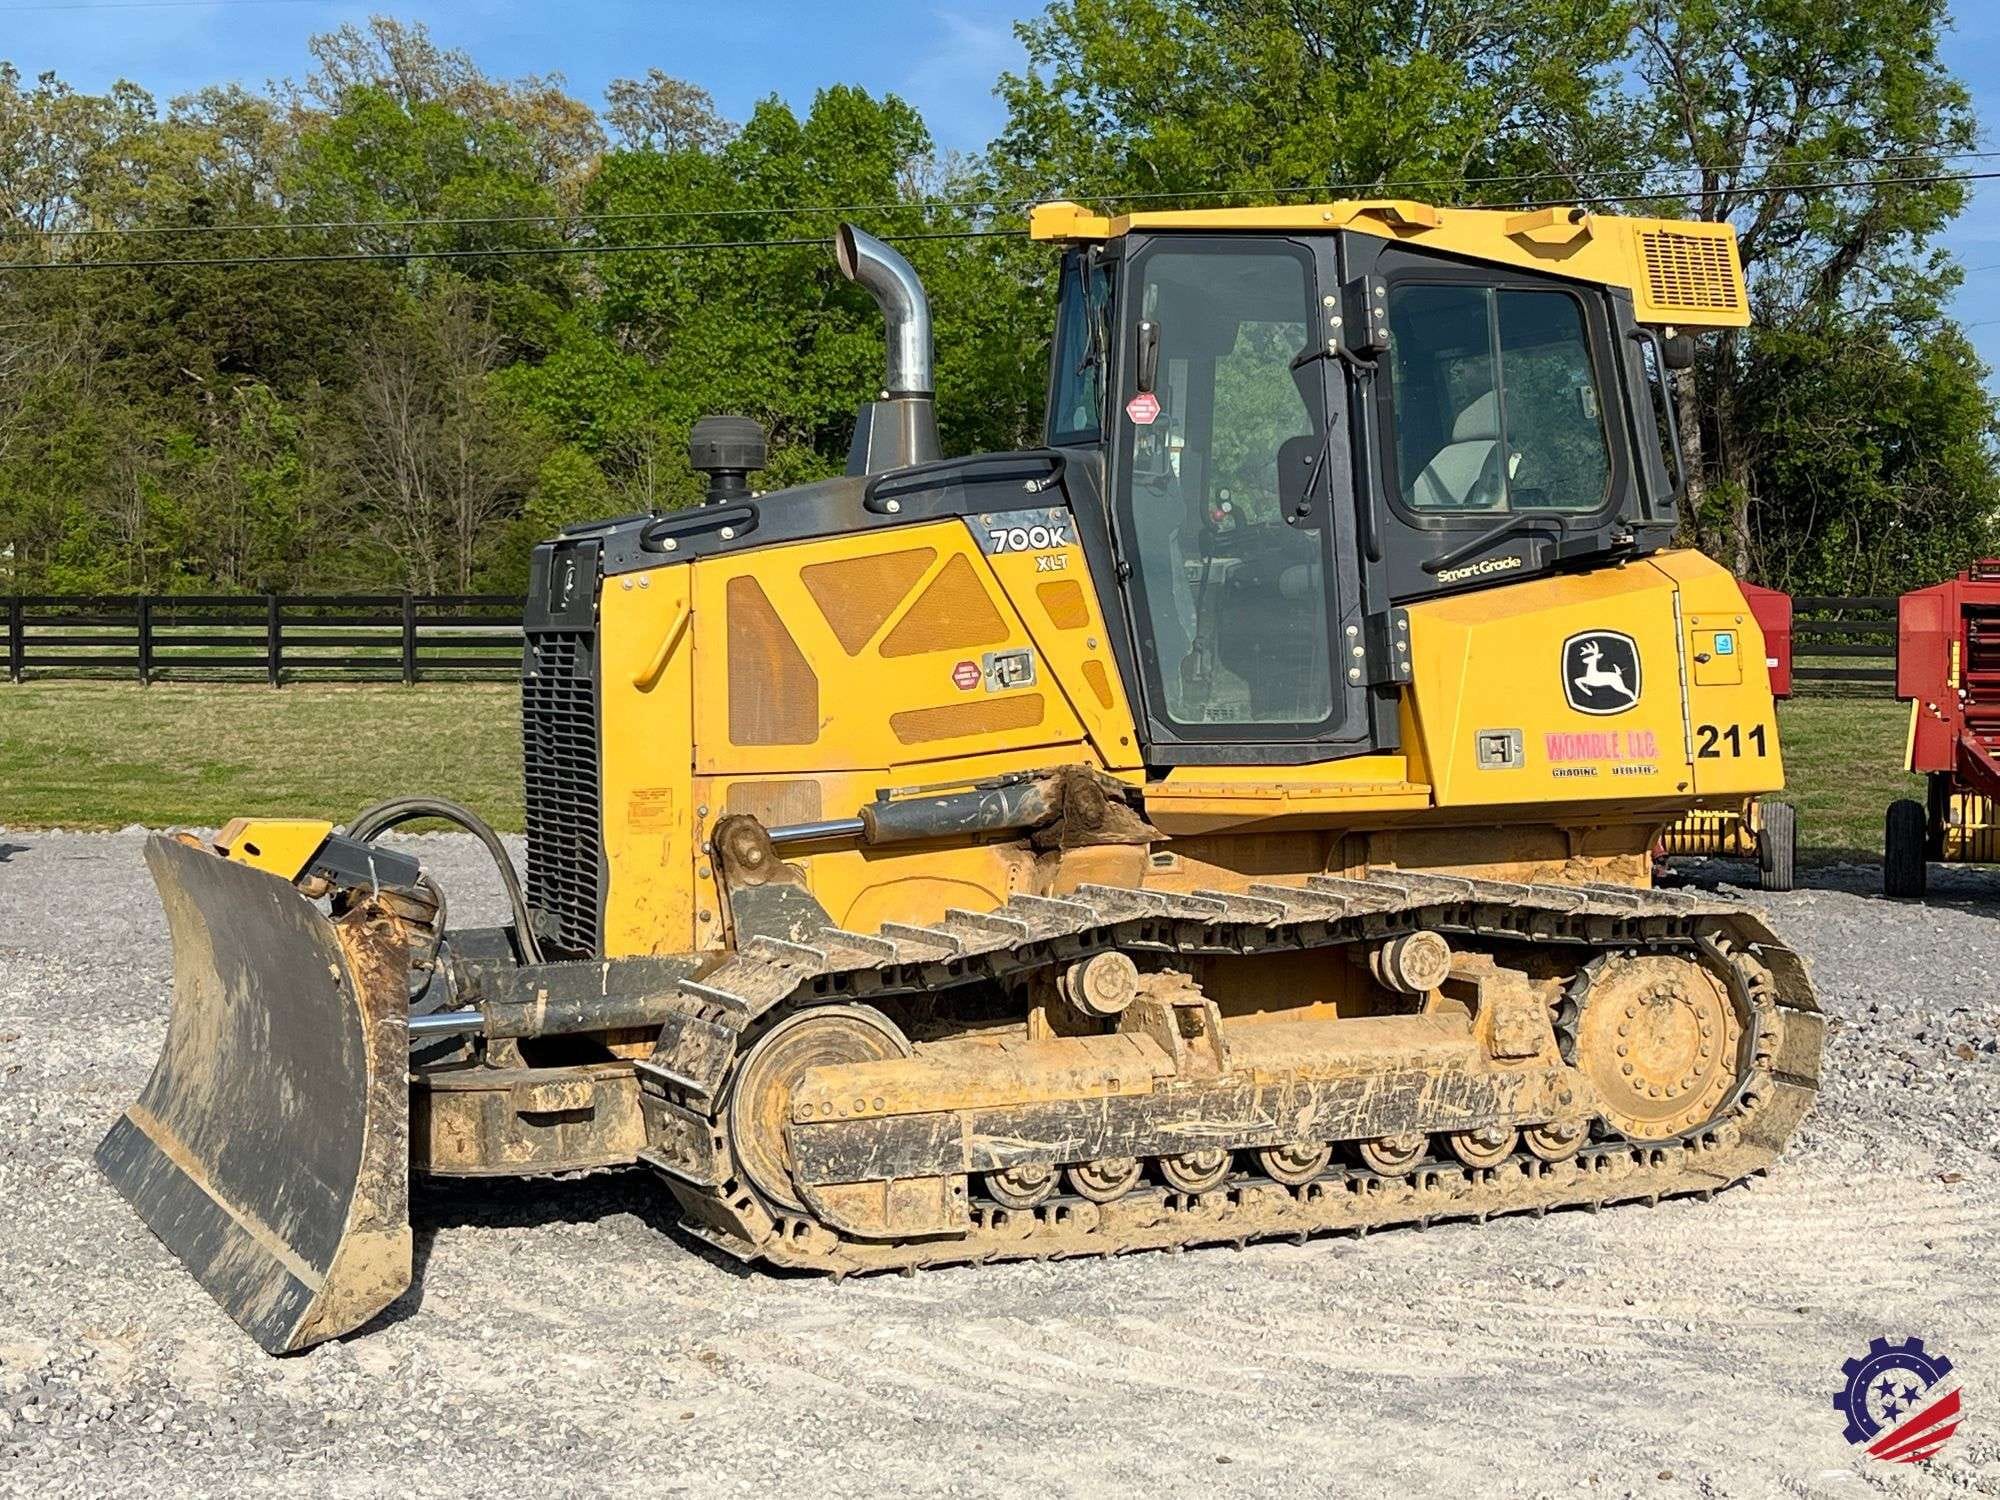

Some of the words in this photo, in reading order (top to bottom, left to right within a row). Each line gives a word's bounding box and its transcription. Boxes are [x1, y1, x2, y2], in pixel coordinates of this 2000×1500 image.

[990, 525, 1067, 554] 700K
[1035, 554, 1068, 573] XLT
[1696, 724, 1766, 758] 211
